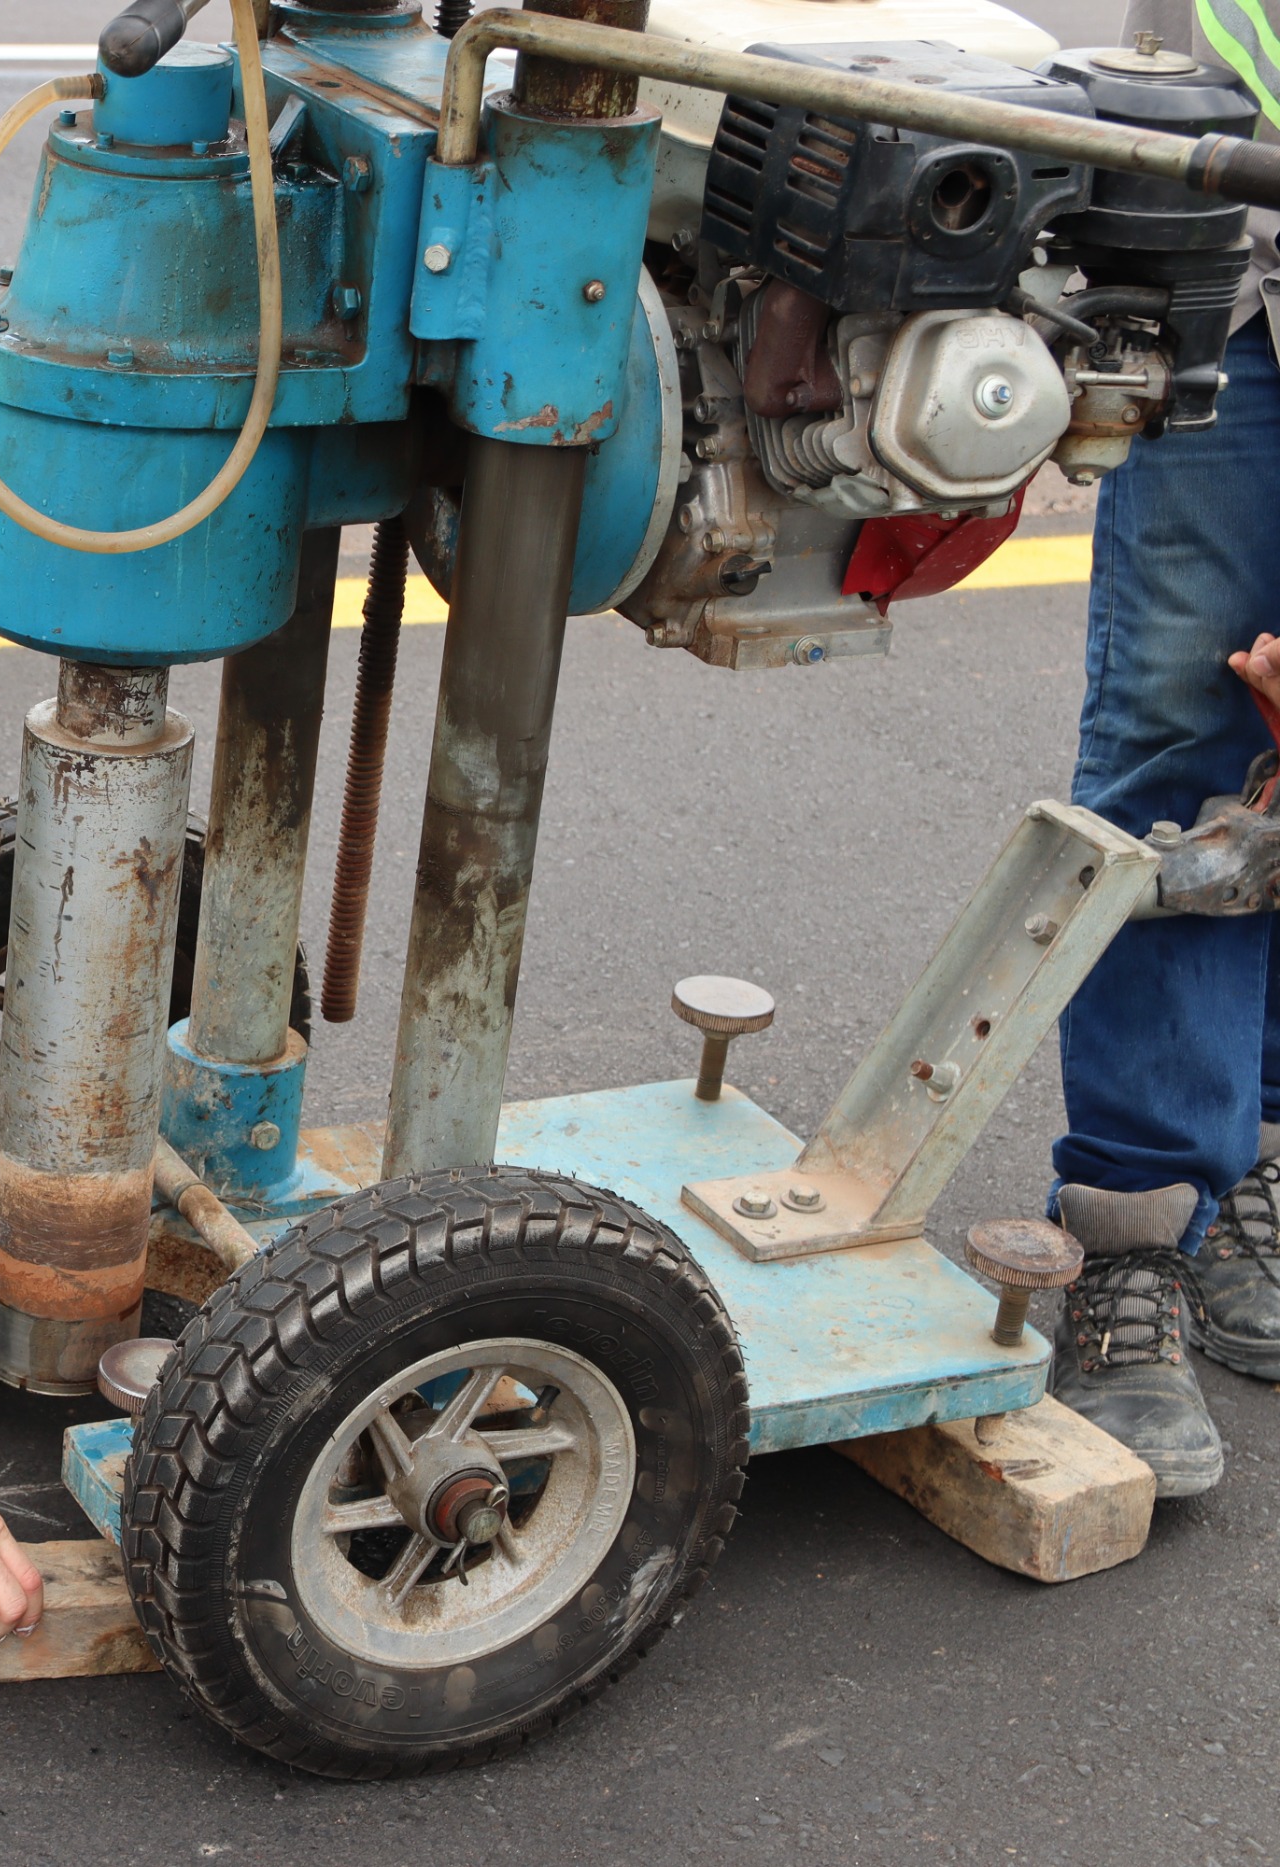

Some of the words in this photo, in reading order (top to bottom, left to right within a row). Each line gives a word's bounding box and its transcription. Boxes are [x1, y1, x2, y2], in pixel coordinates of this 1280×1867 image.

[956, 326, 1026, 349] OHV
[526, 1309, 660, 1403] levorin
[286, 1626, 423, 1718] levorin
